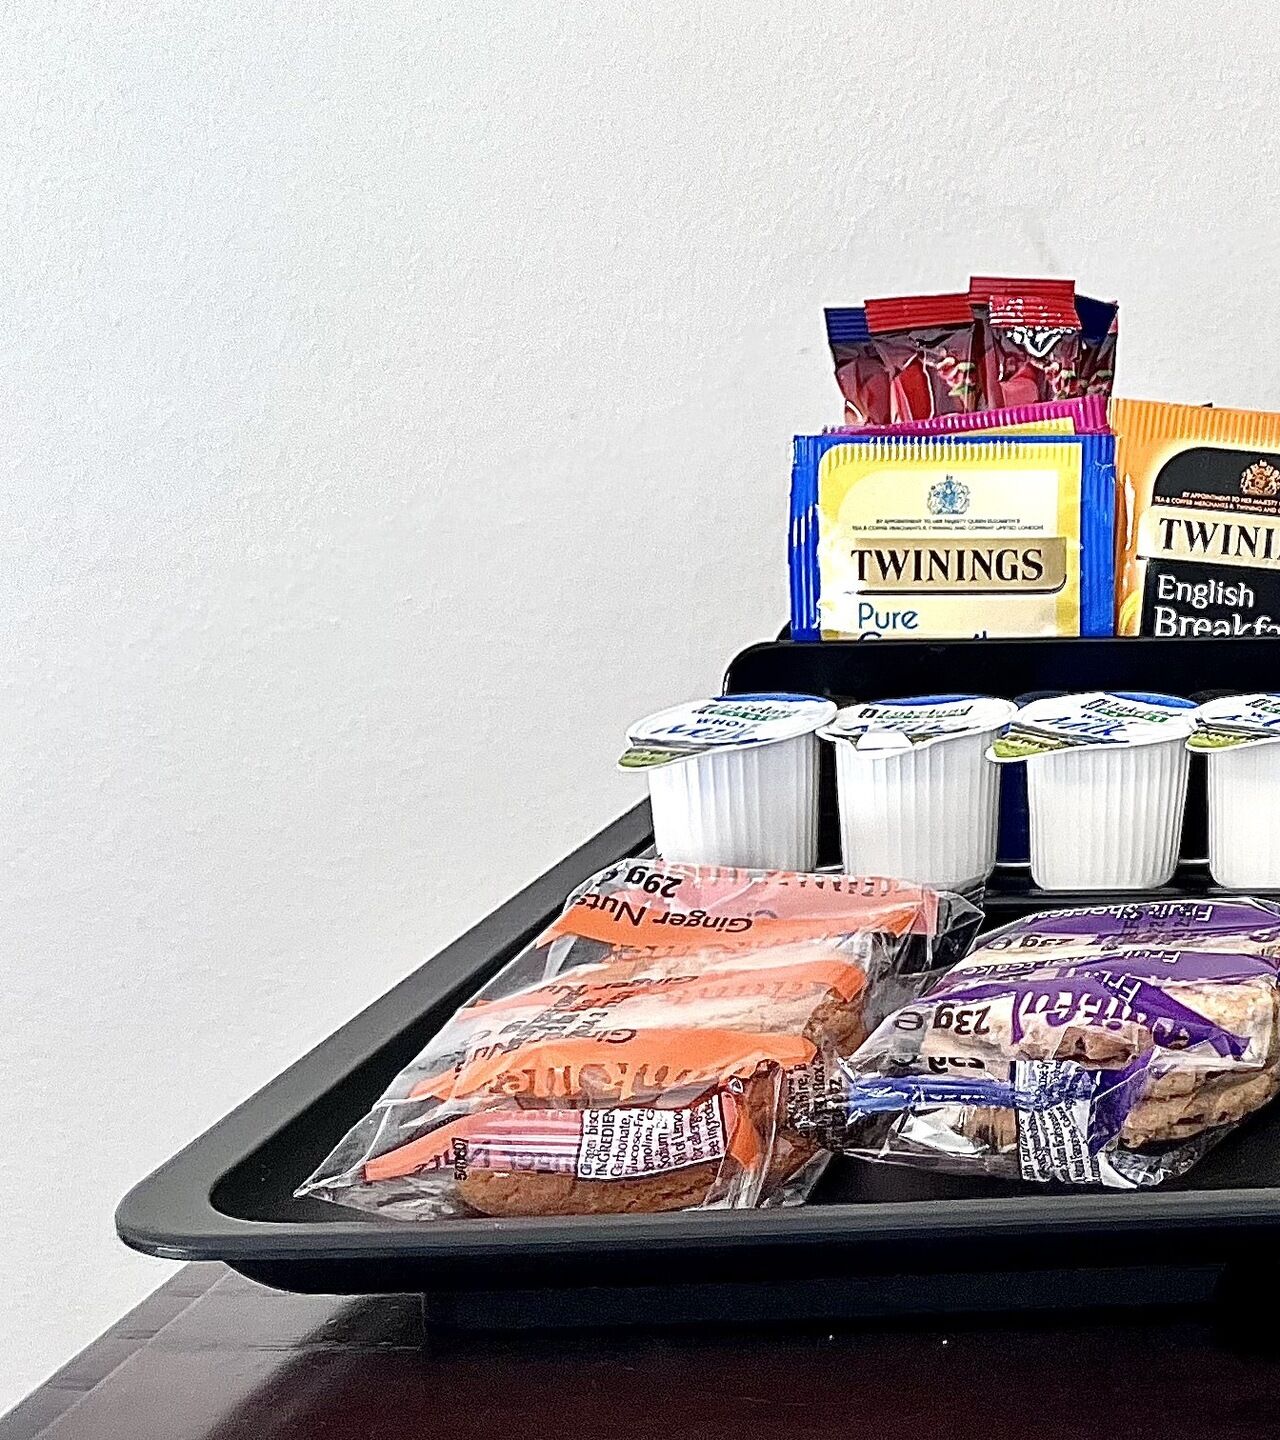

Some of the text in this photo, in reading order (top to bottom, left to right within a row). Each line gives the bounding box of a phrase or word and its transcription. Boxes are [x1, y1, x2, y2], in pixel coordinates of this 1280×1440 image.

[850, 548, 1044, 582] TWININGS
[1157, 574, 1255, 609] English
[857, 602, 919, 630] Pure
[623, 865, 683, 898] 29g
[577, 893, 753, 933] Ginger Nuts
[932, 1002, 992, 1036] 23g
